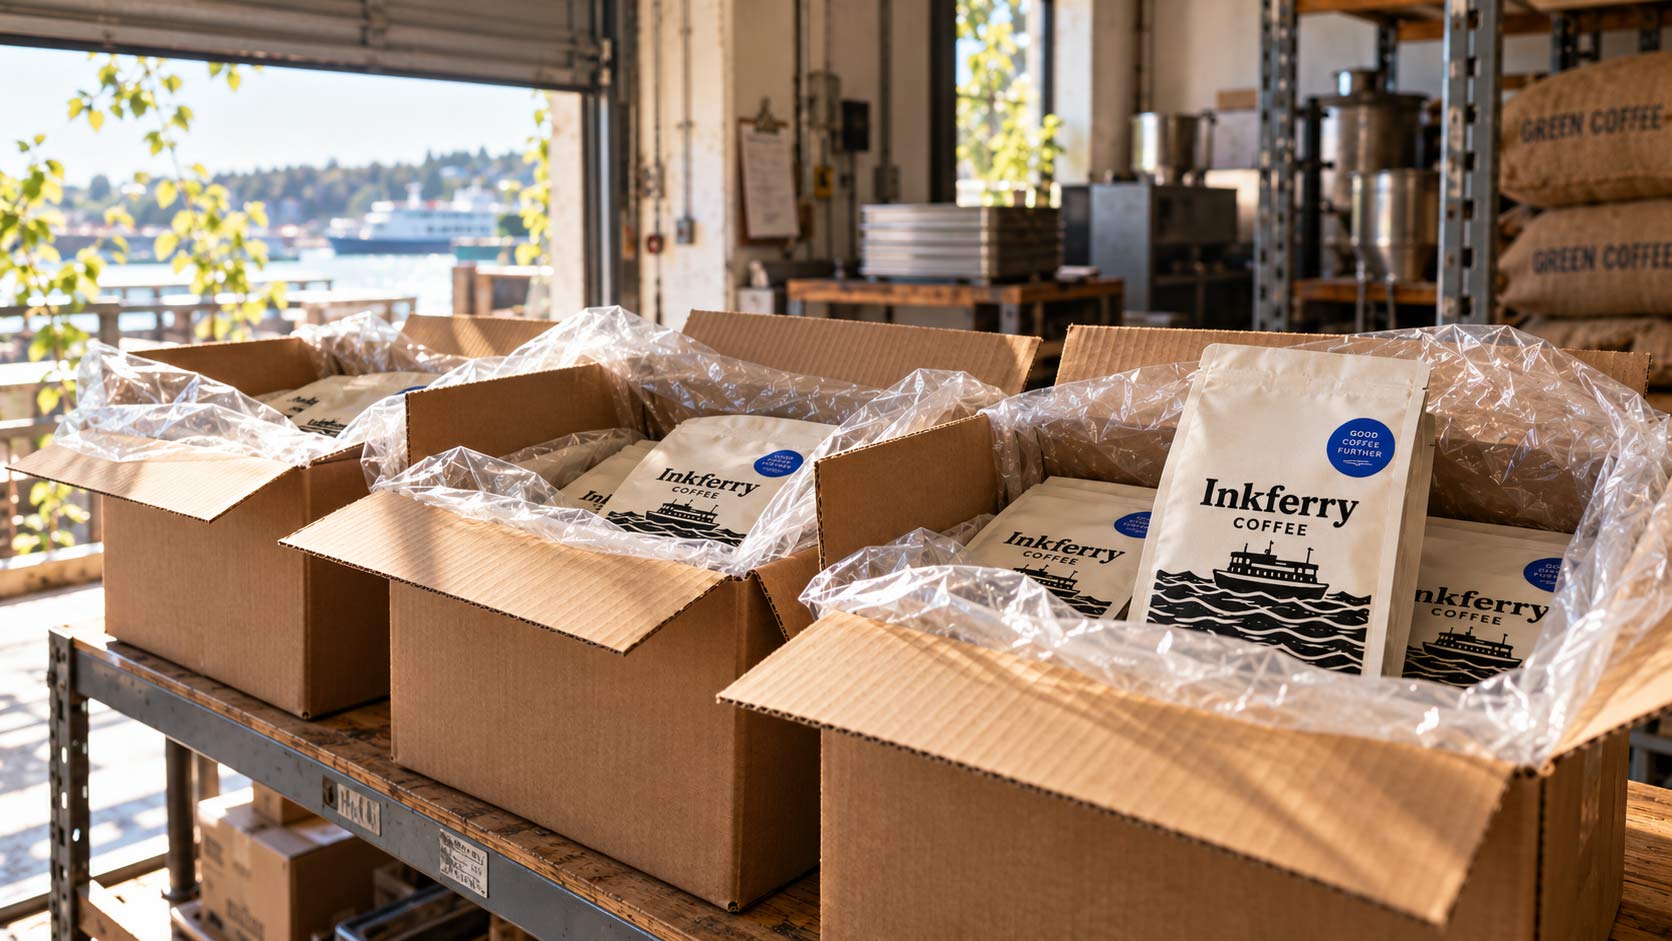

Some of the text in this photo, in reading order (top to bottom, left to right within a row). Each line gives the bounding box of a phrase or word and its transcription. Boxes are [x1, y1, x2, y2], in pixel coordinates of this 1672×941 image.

[1520, 104, 1664, 143] GREEN COFFEE
[1533, 245, 1595, 275] GREEN
[1350, 430, 1378, 438] GOOD
[1337, 447, 1382, 457] FURTHER
[656, 467, 760, 497] Inkferry
[671, 486, 720, 500] COFFEE
[1200, 478, 1359, 528] Inkferry
[1233, 517, 1308, 536] COFFEE
[1003, 531, 1125, 564] Inkferry
[1023, 551, 1079, 565] COFFEE
[1415, 587, 1549, 623] nkferry
[1431, 608, 1502, 625] COFFEE
